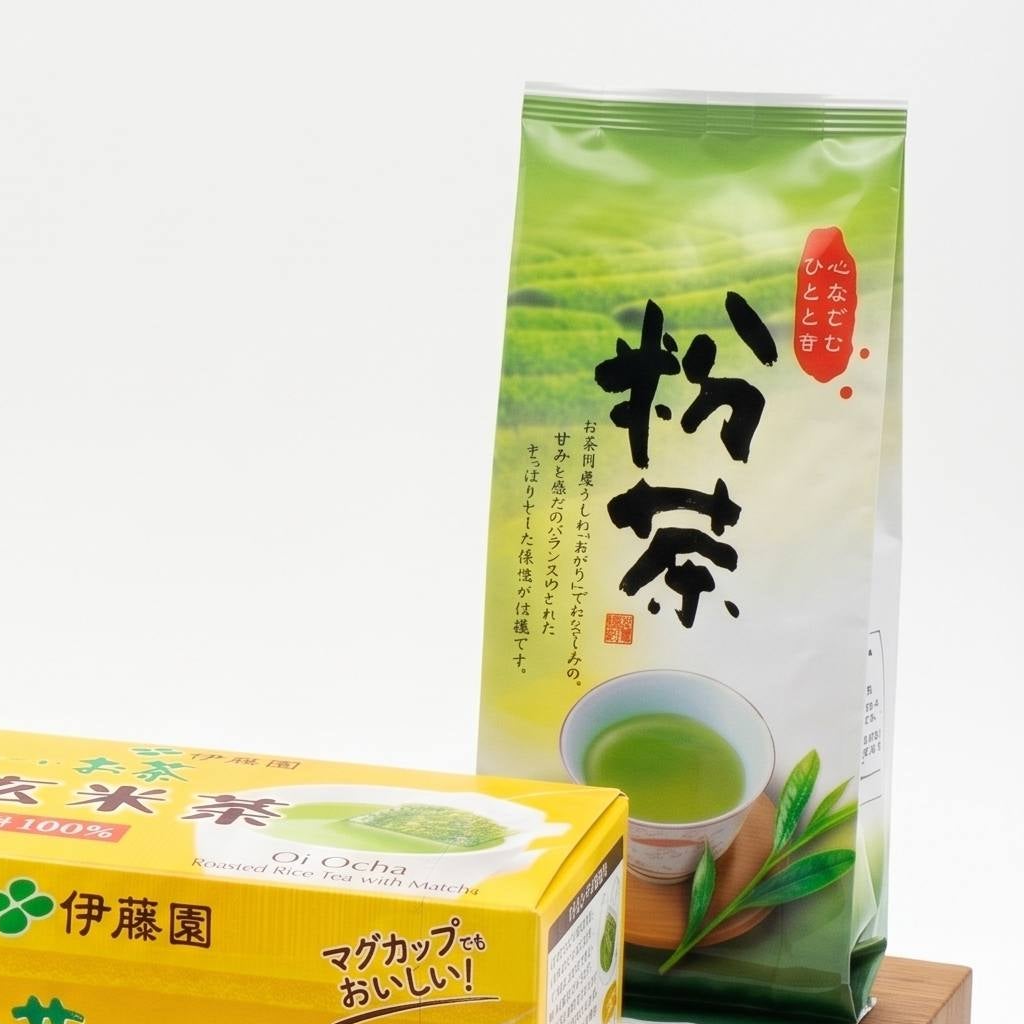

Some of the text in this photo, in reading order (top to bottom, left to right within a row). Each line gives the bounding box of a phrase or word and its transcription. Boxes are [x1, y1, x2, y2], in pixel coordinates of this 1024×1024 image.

[595, 291, 778, 629] 粉茶
[191, 857, 481, 896] Roasted Rice Tea with Matcha
[272, 851, 407, 876] Oi Ocha
[60, 890, 212, 949] 伊藤園
[322, 917, 486, 971] マグカップでも
[340, 957, 473, 1008] おいしい！
